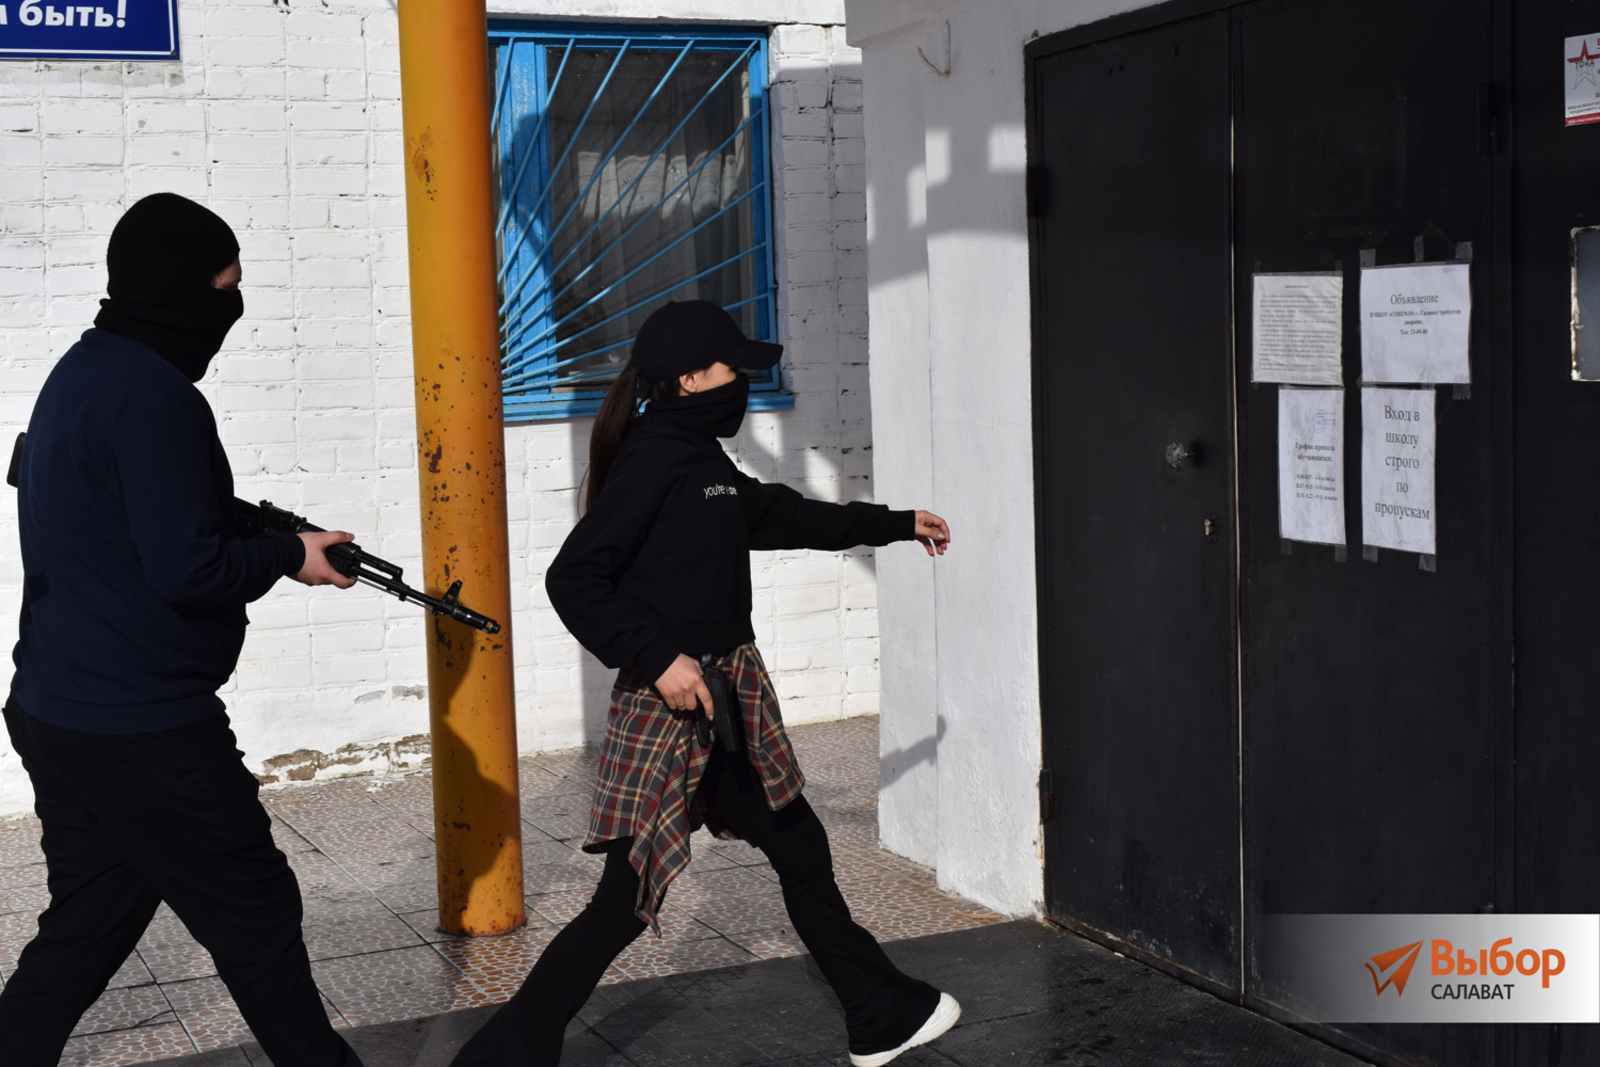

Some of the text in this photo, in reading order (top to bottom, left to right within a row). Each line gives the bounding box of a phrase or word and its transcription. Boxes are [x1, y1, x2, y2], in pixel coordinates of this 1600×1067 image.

[19, 0, 127, 28] быть!
[1390, 294, 1439, 305] Объявление
[1384, 404, 1420, 422] Вход в
[1295, 442, 1313, 451] График
[1385, 432, 1419, 449] школу
[1385, 456, 1419, 471] строго
[1396, 481, 1408, 493] по
[1375, 502, 1430, 520] пропускам
